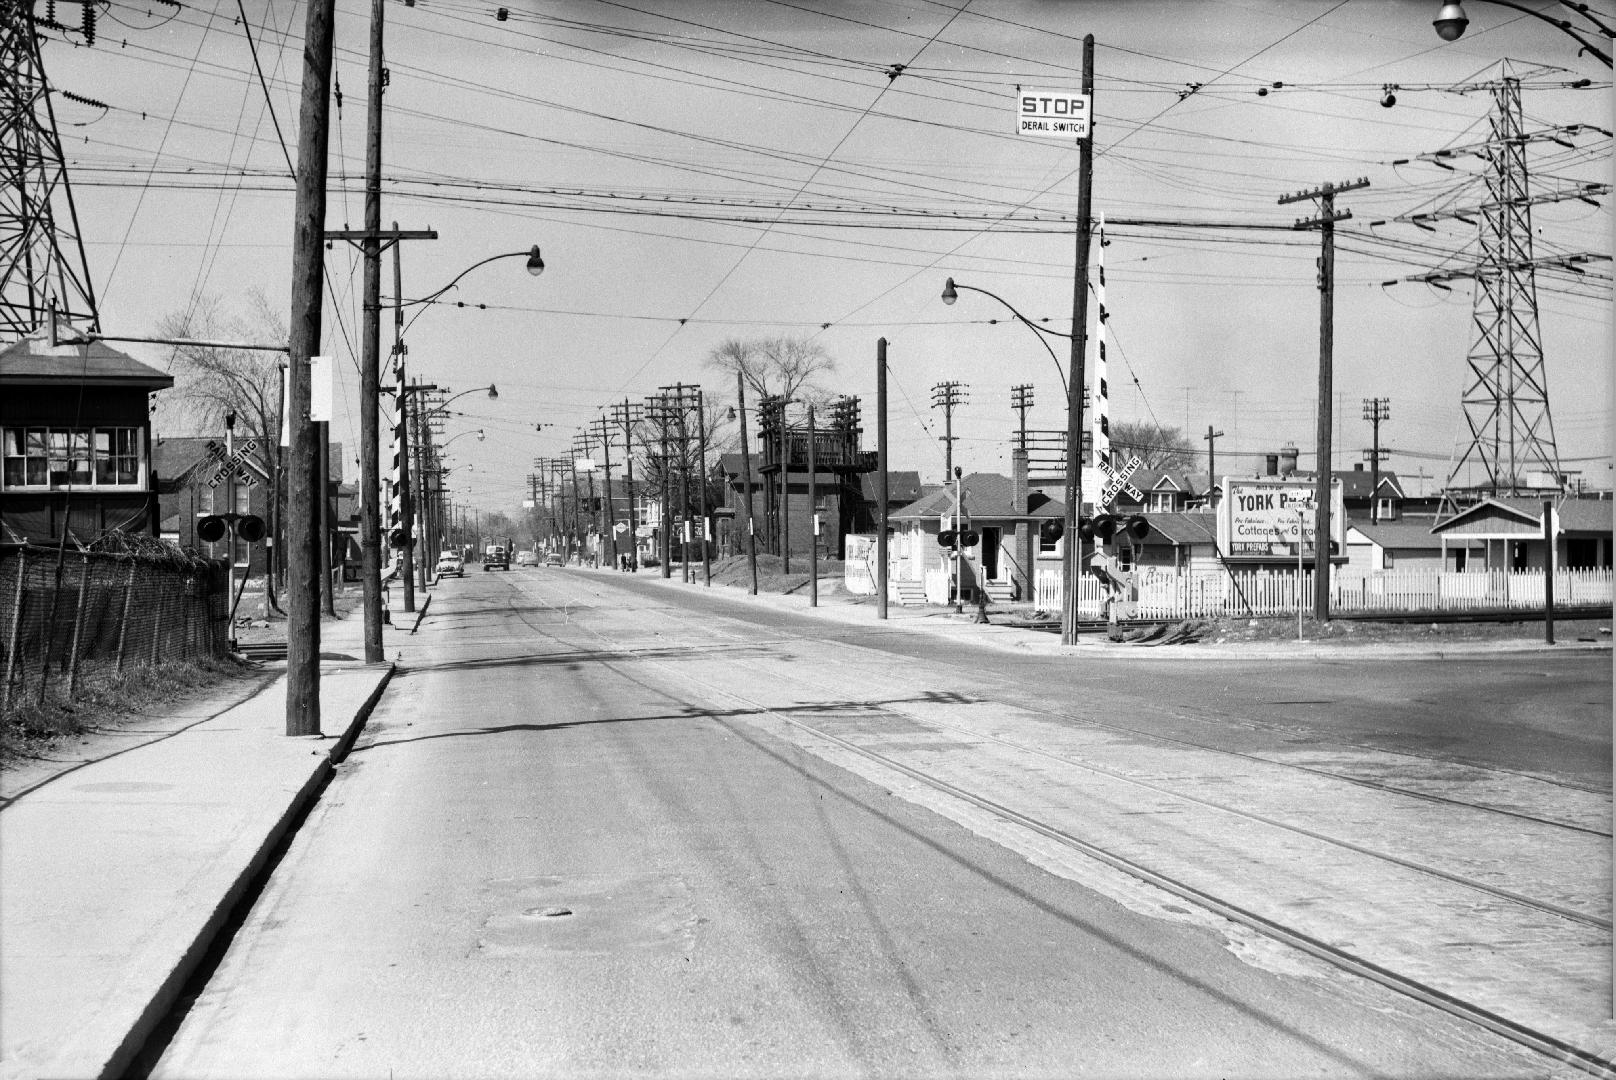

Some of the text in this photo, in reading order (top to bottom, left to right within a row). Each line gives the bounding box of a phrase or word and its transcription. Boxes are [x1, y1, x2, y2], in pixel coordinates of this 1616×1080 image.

[1023, 97, 1084, 115] STOP
[1022, 121, 1085, 133] DERAIL SWITCH
[206, 441, 226, 462] RAIL
[208, 441, 257, 489] CROSSING
[1098, 461, 1115, 479] RAIL
[237, 467, 257, 487] WAY
[1102, 458, 1140, 505] CROSSING
[1124, 482, 1141, 499] WAY
[1238, 493, 1274, 511] YORK
